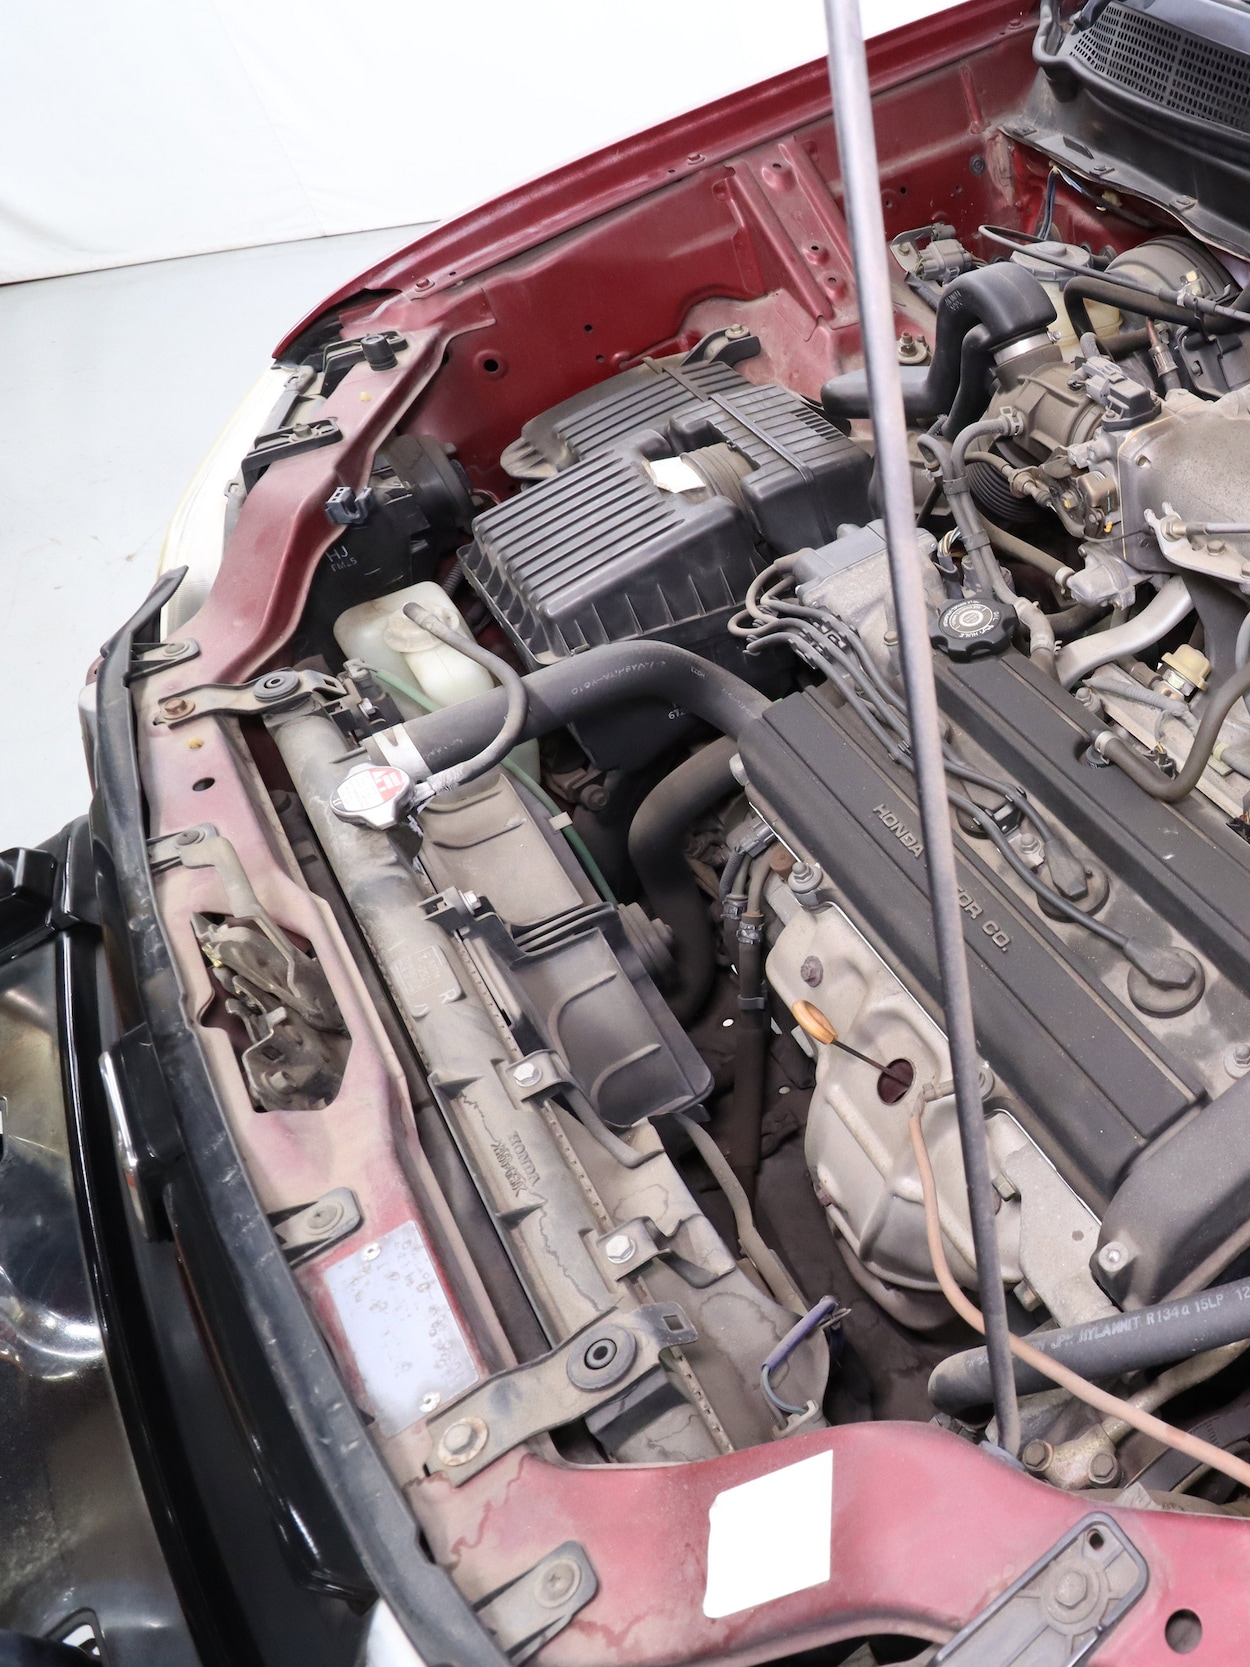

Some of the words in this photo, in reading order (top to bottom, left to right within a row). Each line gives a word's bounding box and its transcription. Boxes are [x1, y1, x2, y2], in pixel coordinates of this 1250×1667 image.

[872, 802, 925, 859] HONDA
[982, 919, 1012, 953] CO.
[509, 1130, 541, 1188] HONDA
[1195, 1294, 1225, 1314] 15LP
